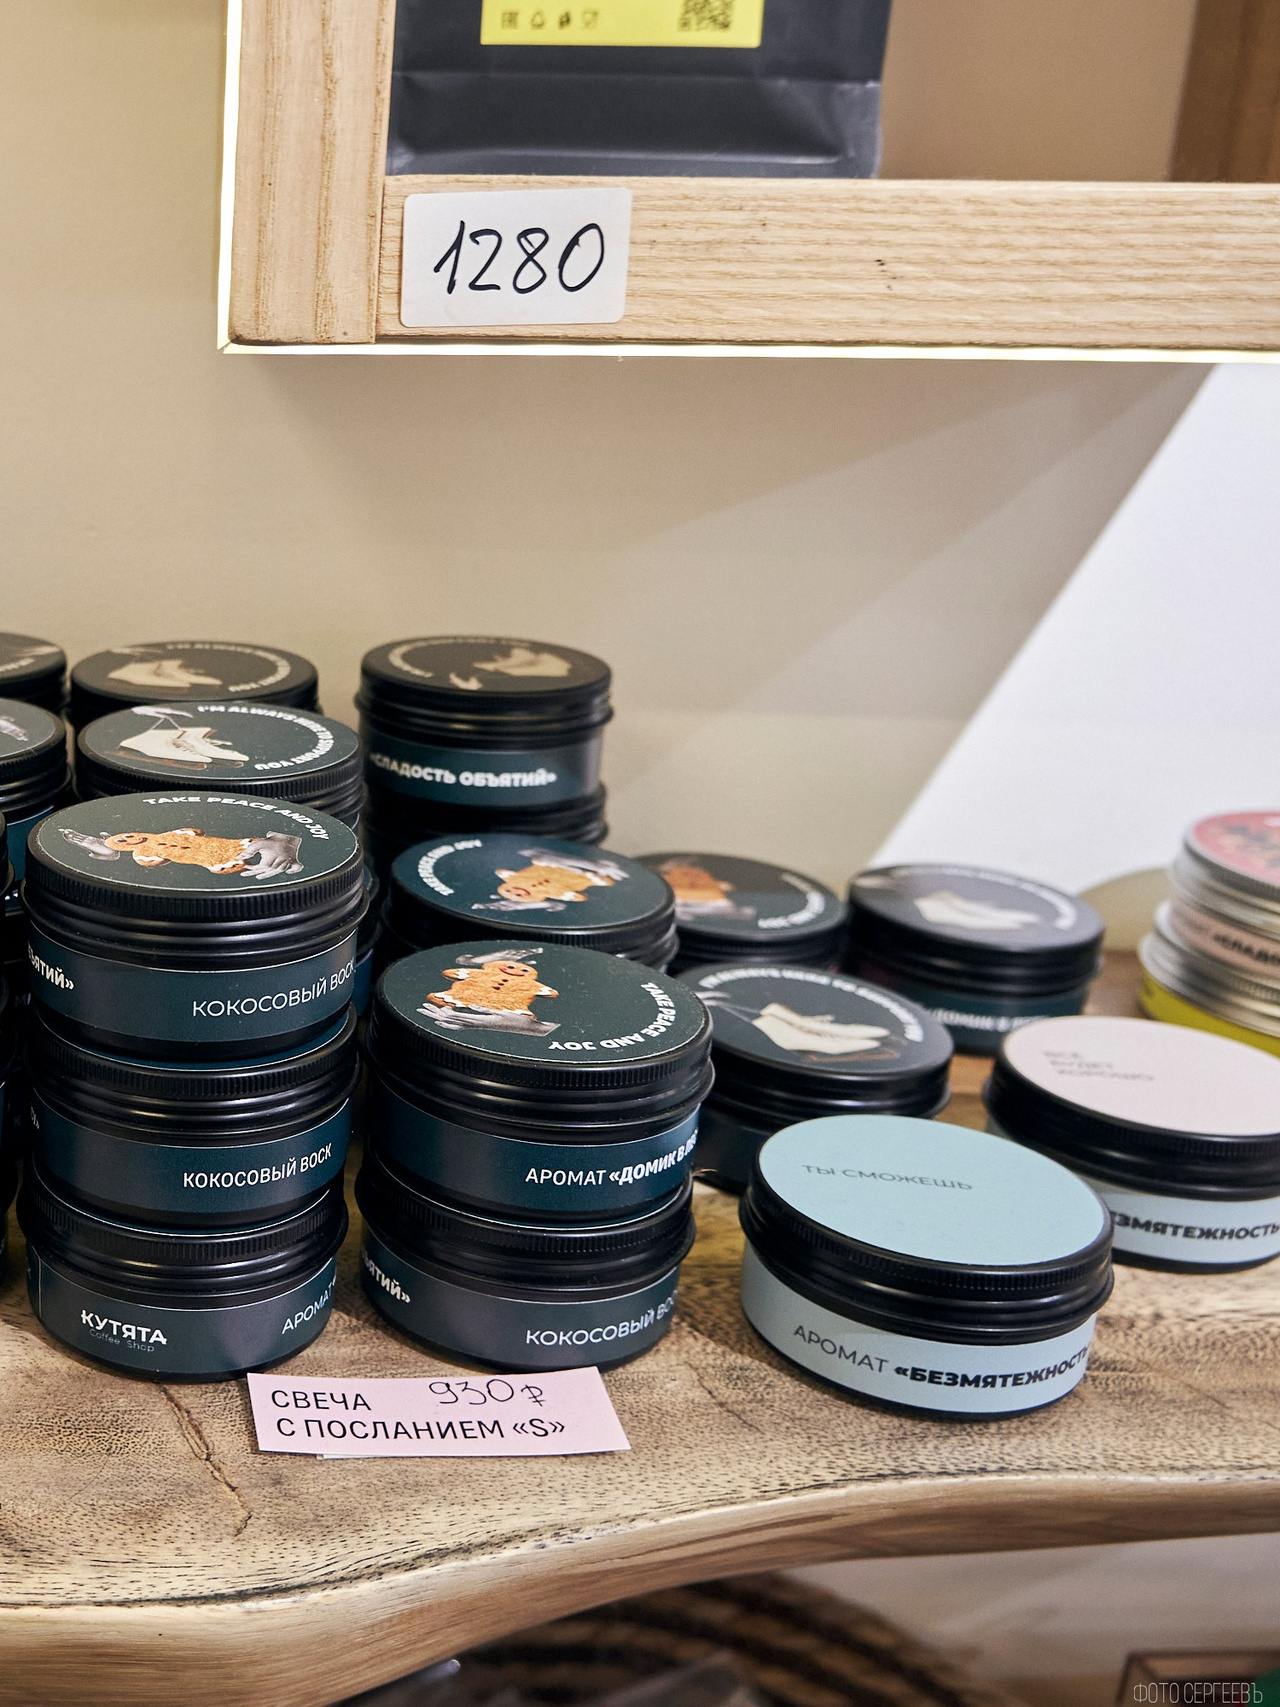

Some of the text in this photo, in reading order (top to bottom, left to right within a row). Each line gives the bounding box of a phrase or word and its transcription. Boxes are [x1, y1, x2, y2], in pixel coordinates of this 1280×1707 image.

[434, 220, 605, 294] 1280
[197, 704, 226, 713] I'M
[227, 705, 298, 721] ALWAYS
[254, 760, 295, 771] YOU
[143, 796, 330, 841] TAKE PEACE AND JOY
[192, 975, 327, 1018] КОКОСОВЫЙ
[548, 982, 677, 1051] TAKE PEACE AND JOY
[183, 1142, 332, 1189] КОКОСОВЫЙ ВОСК
[525, 1168, 606, 1187] АРОМАТ
[609, 1150, 677, 1186] «ДОМИК
[676, 1145, 685, 1162] В
[802, 1165, 973, 1190] ТЫ СМОЖЕШЬ
[81, 1309, 167, 1345] КУТЯТА
[282, 1282, 333, 1335] АРОМАТ
[88, 1328, 155, 1354] Coffee Shop
[526, 1309, 655, 1346] КОКОСОВЫЙ
[793, 1325, 889, 1373] АРОМАТ
[270, 1389, 371, 1411] СВЕЧА
[276, 1417, 566, 1440] С ПОСЛАНИЕМ «S»
